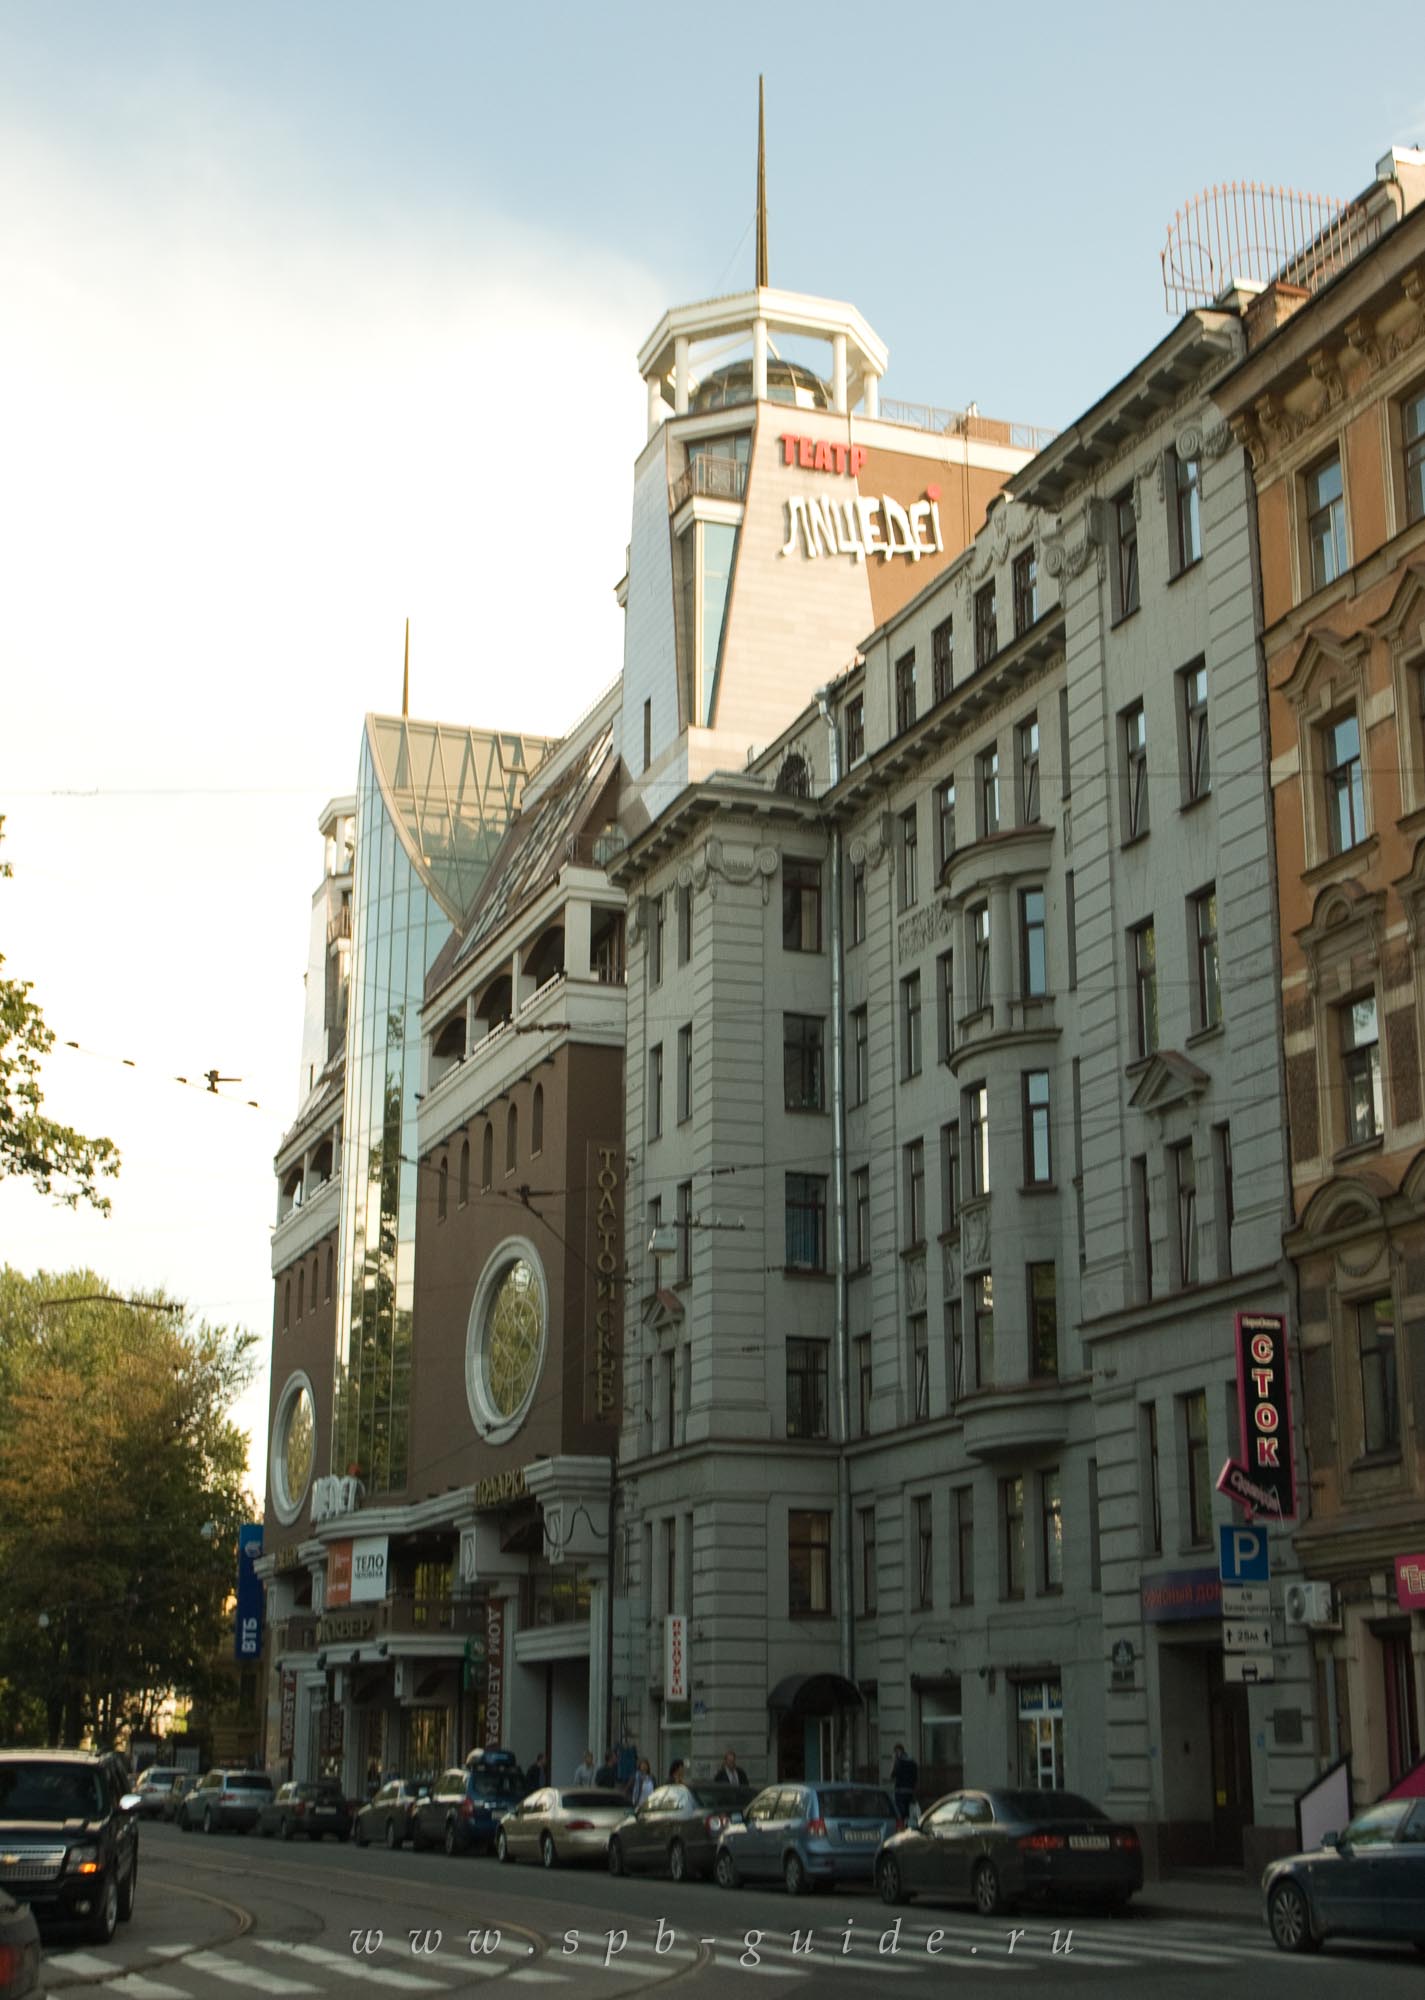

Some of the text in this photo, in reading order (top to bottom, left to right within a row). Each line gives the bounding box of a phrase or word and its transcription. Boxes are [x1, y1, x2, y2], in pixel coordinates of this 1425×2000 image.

[781, 434, 868, 477] ТЕАТР
[1250, 1333, 1280, 1468] СТОК
[354, 1553, 385, 1571] ТЕЛО
[1233, 1530, 1260, 1577] P
[241, 1617, 259, 1653] ВТБ
[485, 1605, 501, 1746] ДОМ ДЕКОРА
